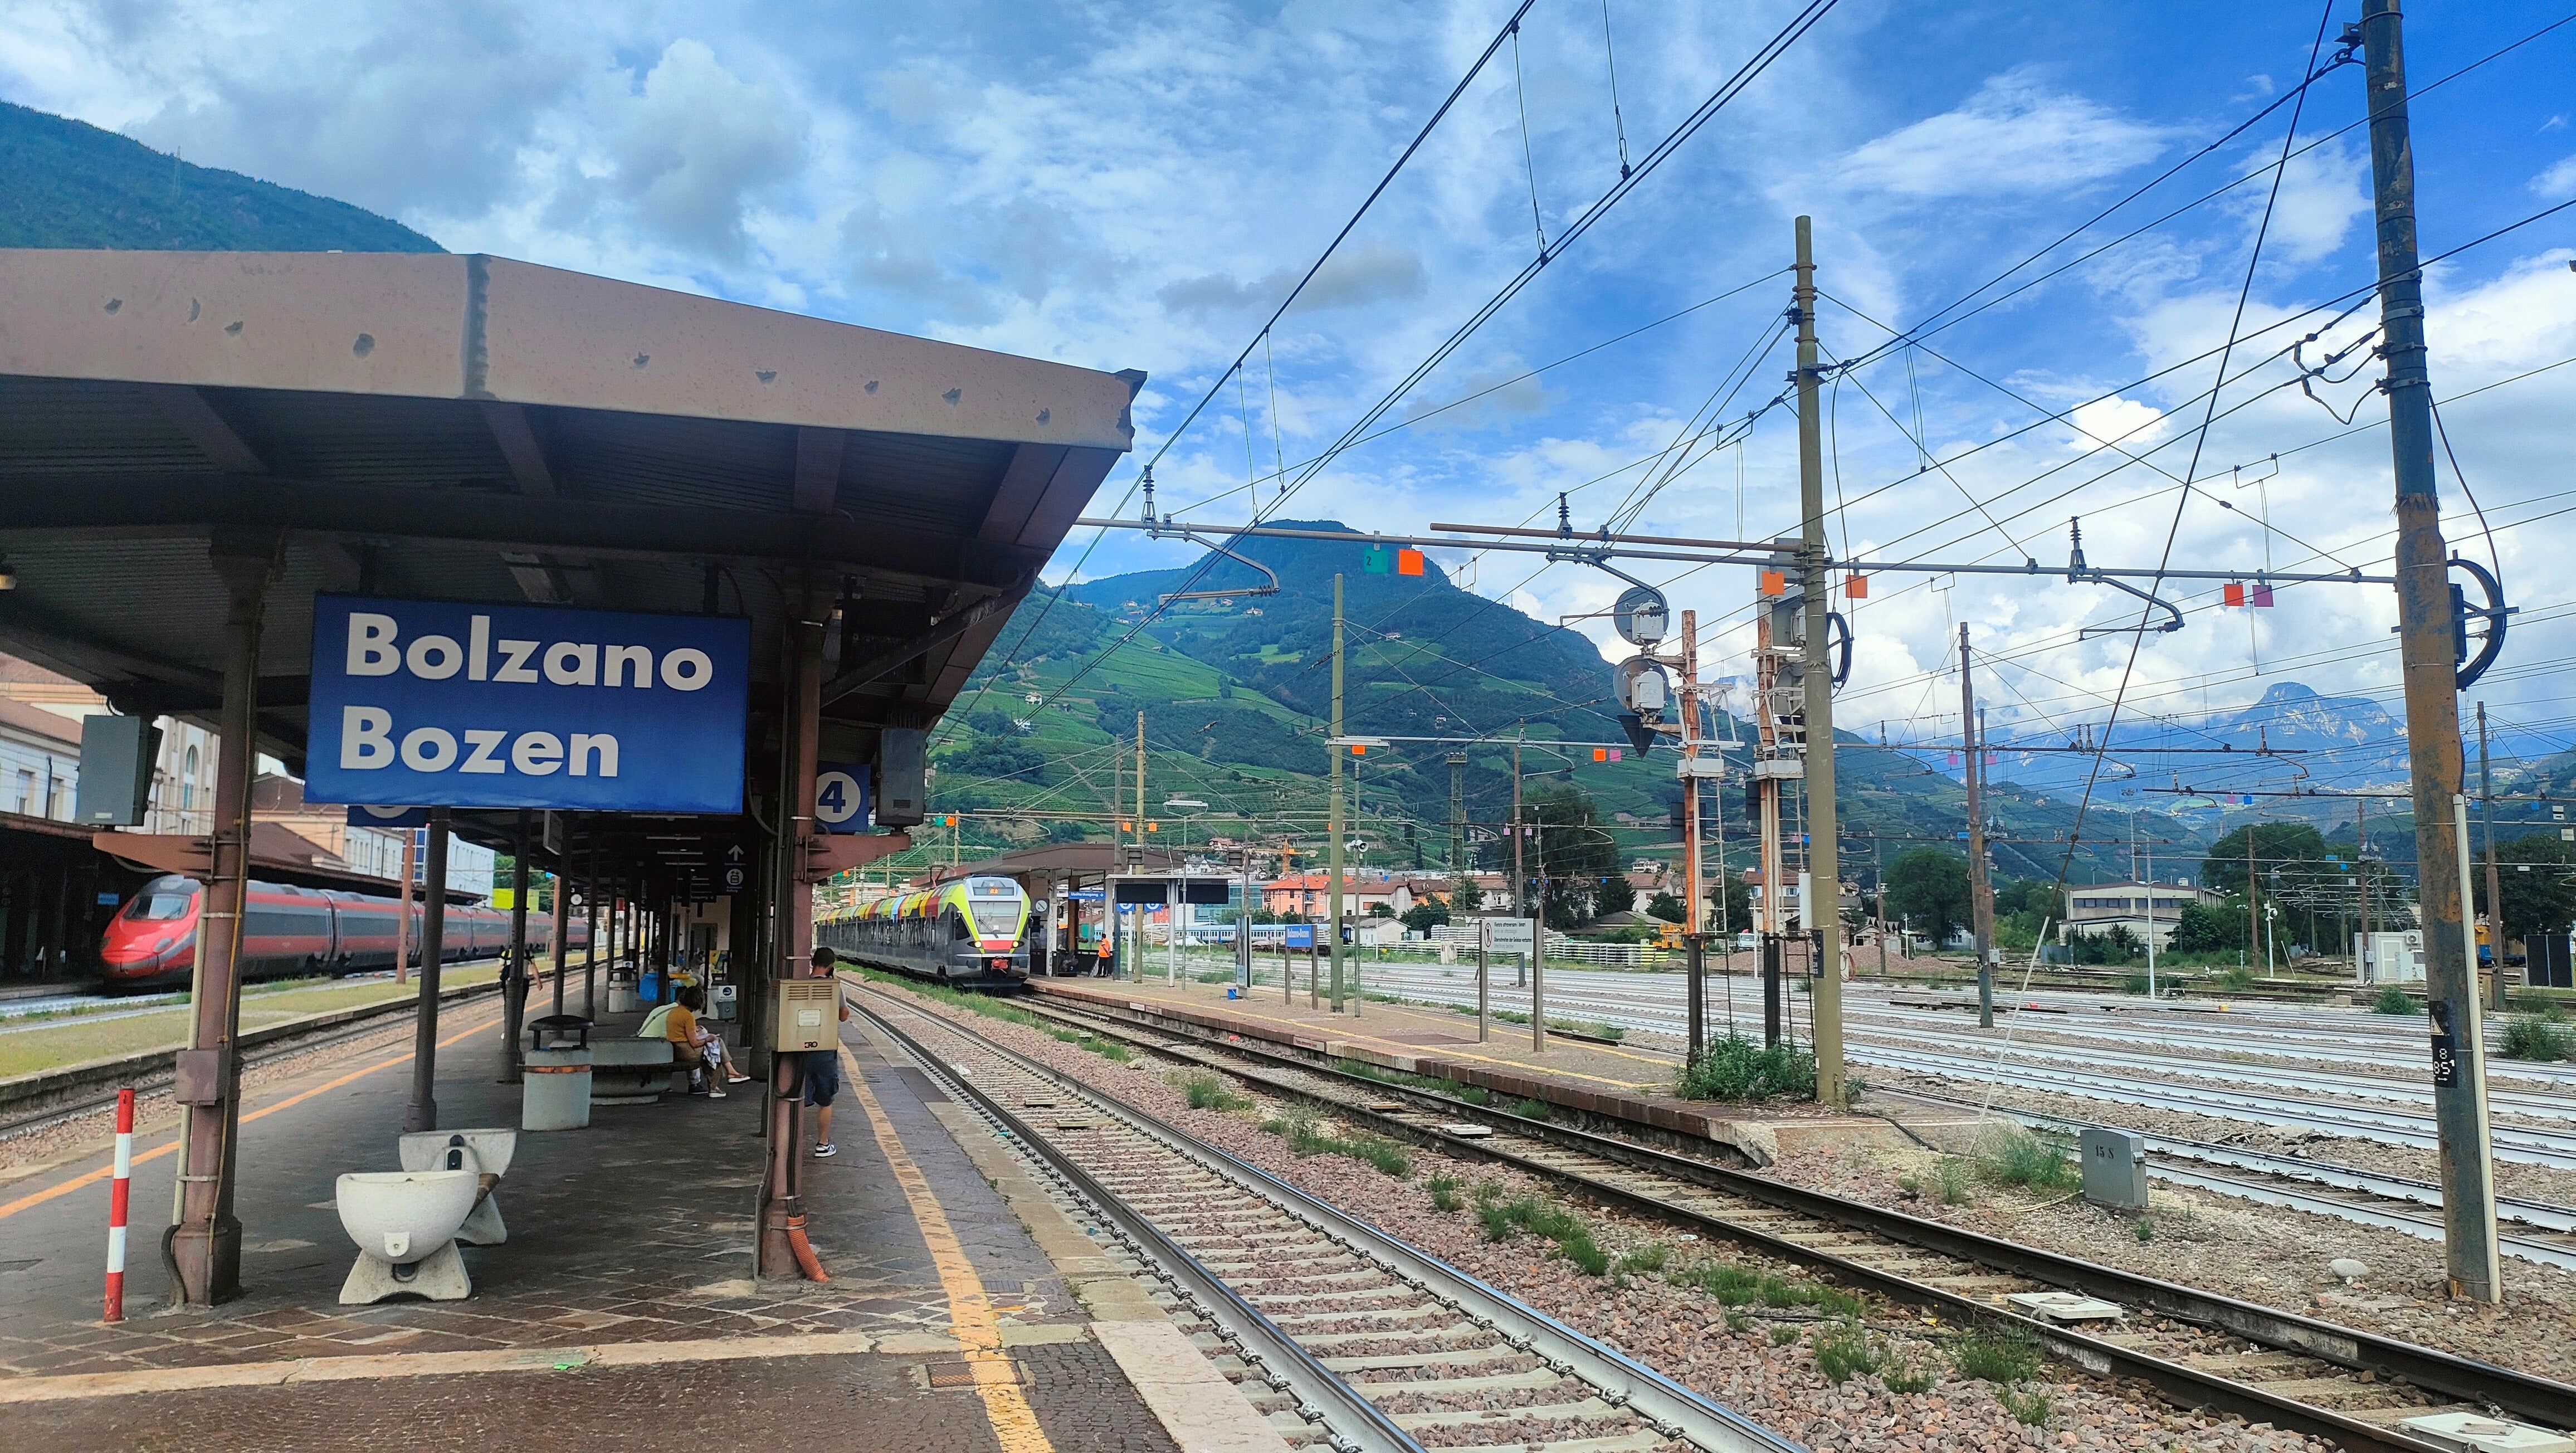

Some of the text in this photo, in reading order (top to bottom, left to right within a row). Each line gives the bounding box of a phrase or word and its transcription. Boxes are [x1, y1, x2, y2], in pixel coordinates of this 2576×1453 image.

[1366, 555, 1372, 566] 2
[346, 612, 713, 691] Bolzano
[340, 705, 619, 777] Bozen
[818, 781, 846, 813] 4
[2439, 1048, 2447, 1059] 8
[2095, 1145, 2105, 1158] 15
